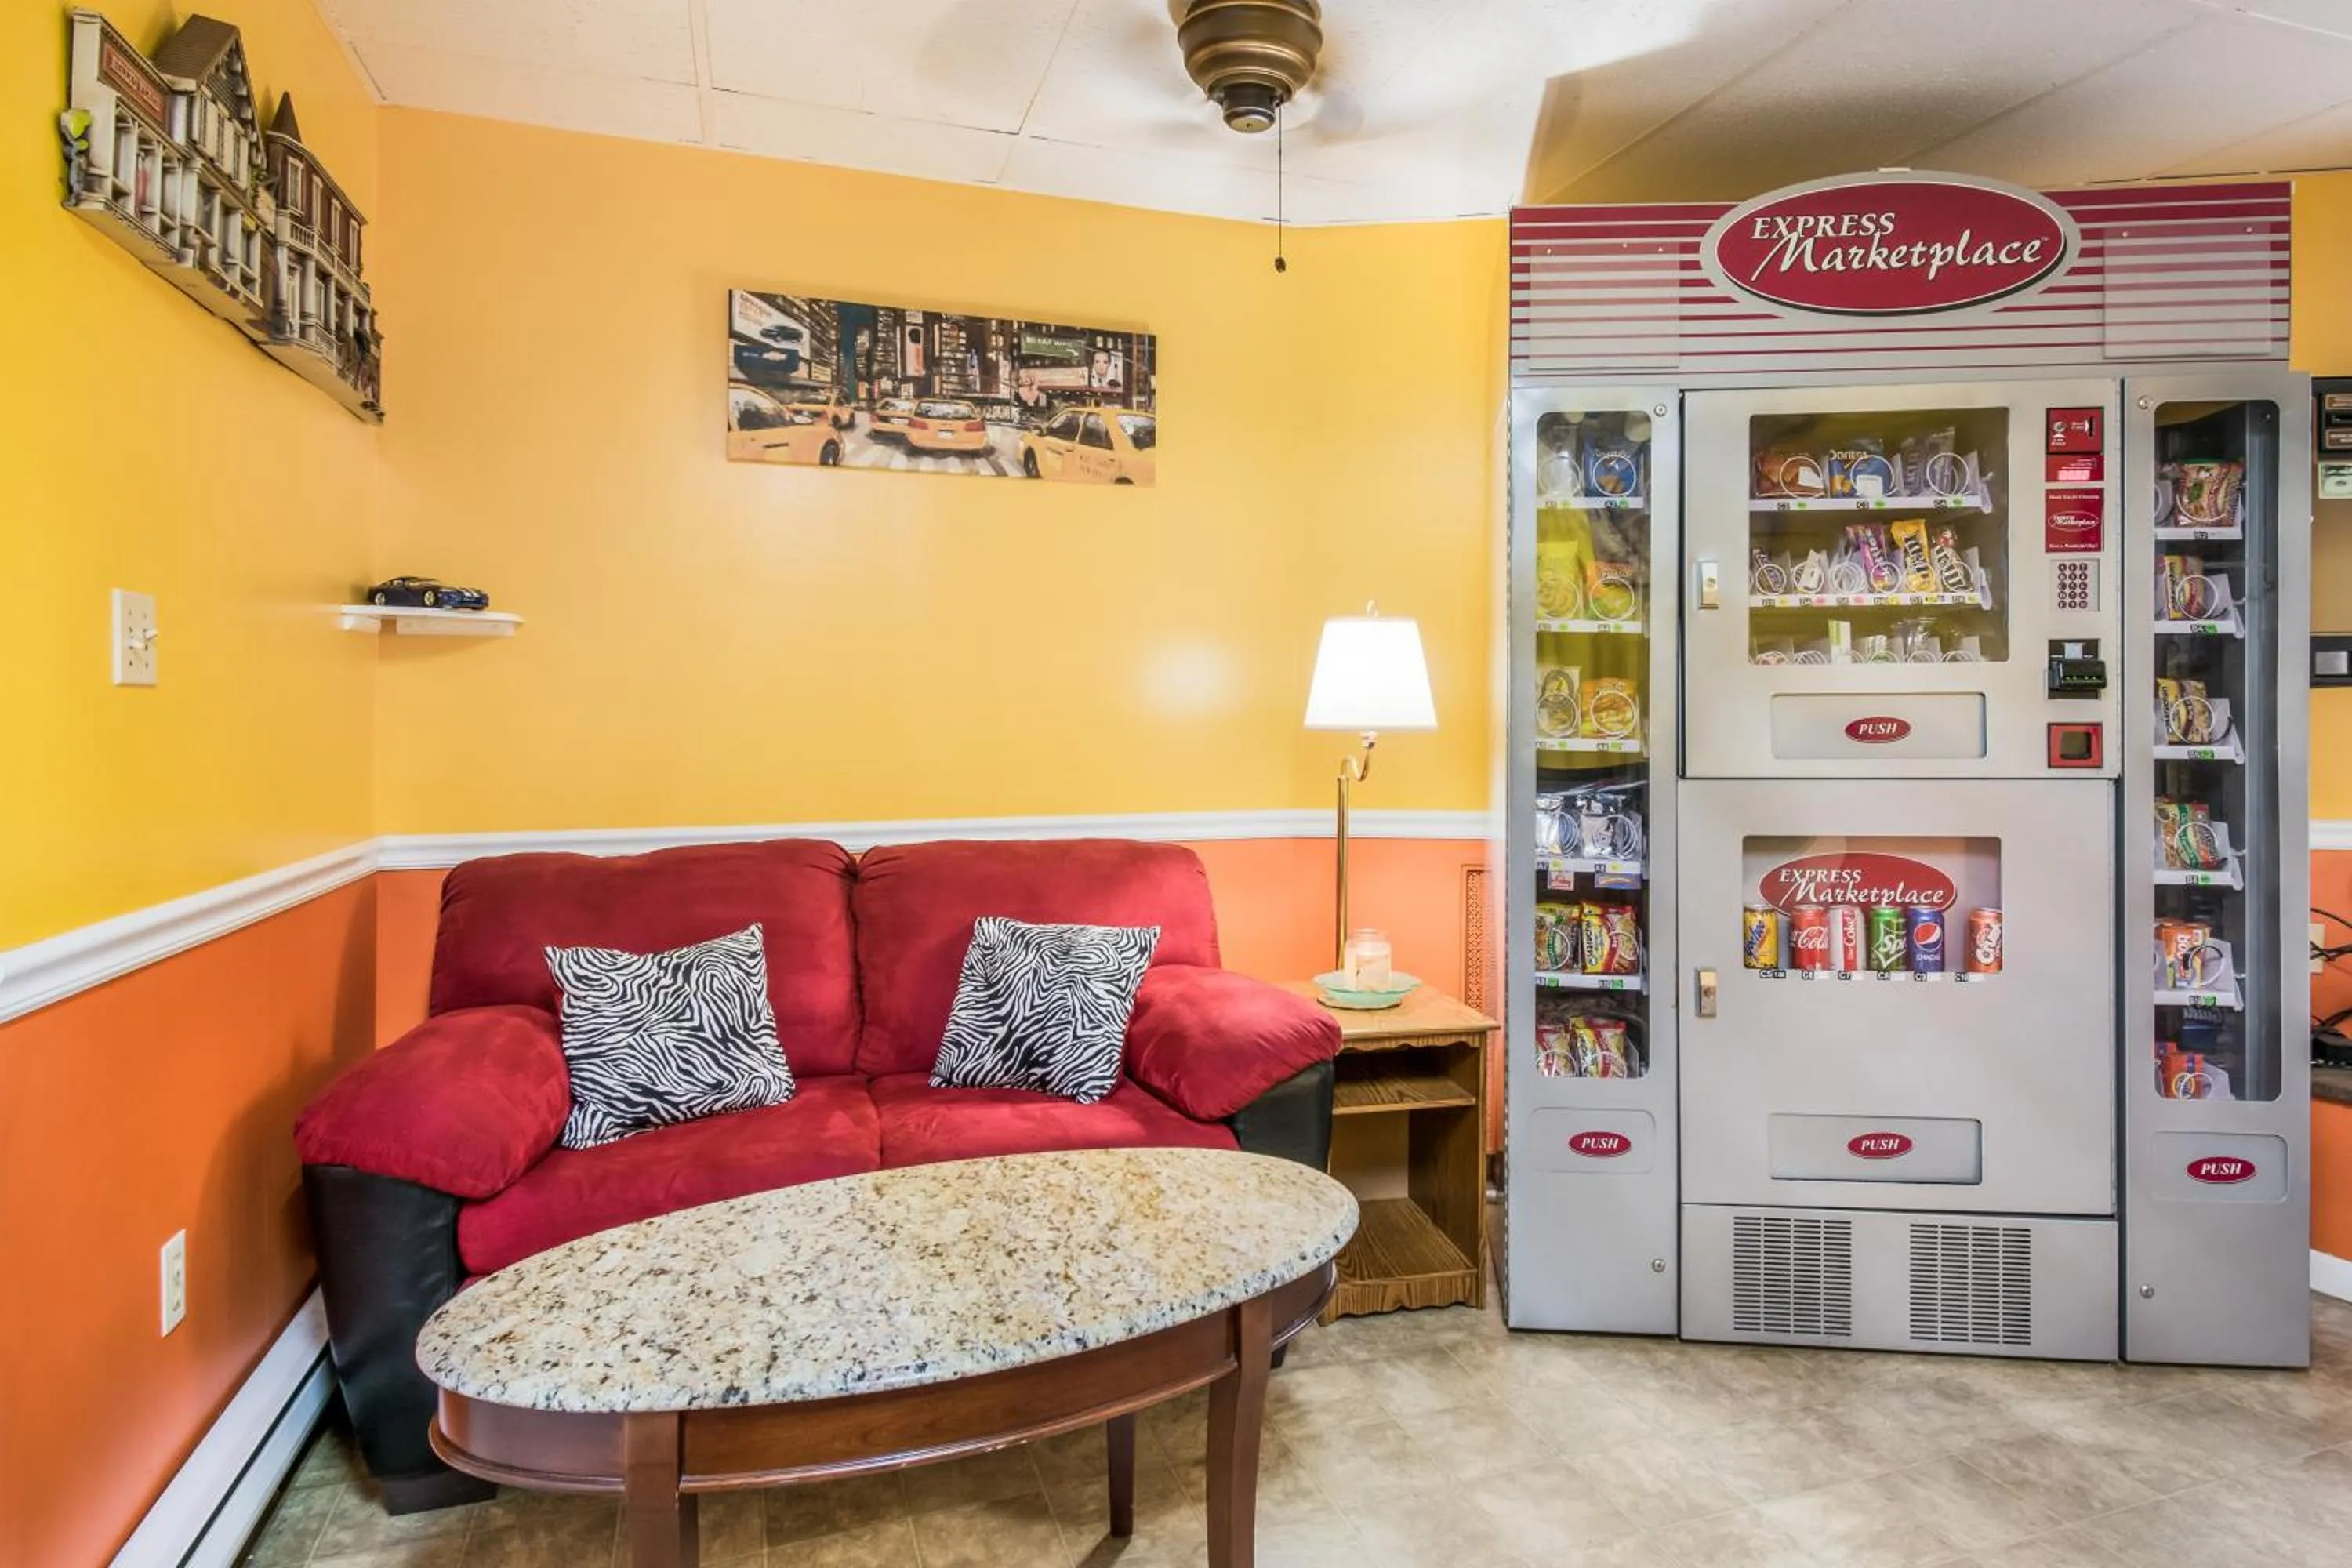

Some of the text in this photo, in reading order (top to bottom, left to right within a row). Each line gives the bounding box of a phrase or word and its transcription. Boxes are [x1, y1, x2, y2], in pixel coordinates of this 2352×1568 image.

[1751, 212, 1896, 240] EXPRESS
[1750, 228, 2042, 282] Marketplace
[1859, 722, 1897, 735] PUSH
[1780, 869, 1863, 884] EXPRESS
[1779, 880, 1945, 907] Marketplace
[1581, 1137, 1619, 1149] PUSH
[1860, 1138, 1900, 1151] PUSH
[2201, 1163, 2242, 1175] PUSH
